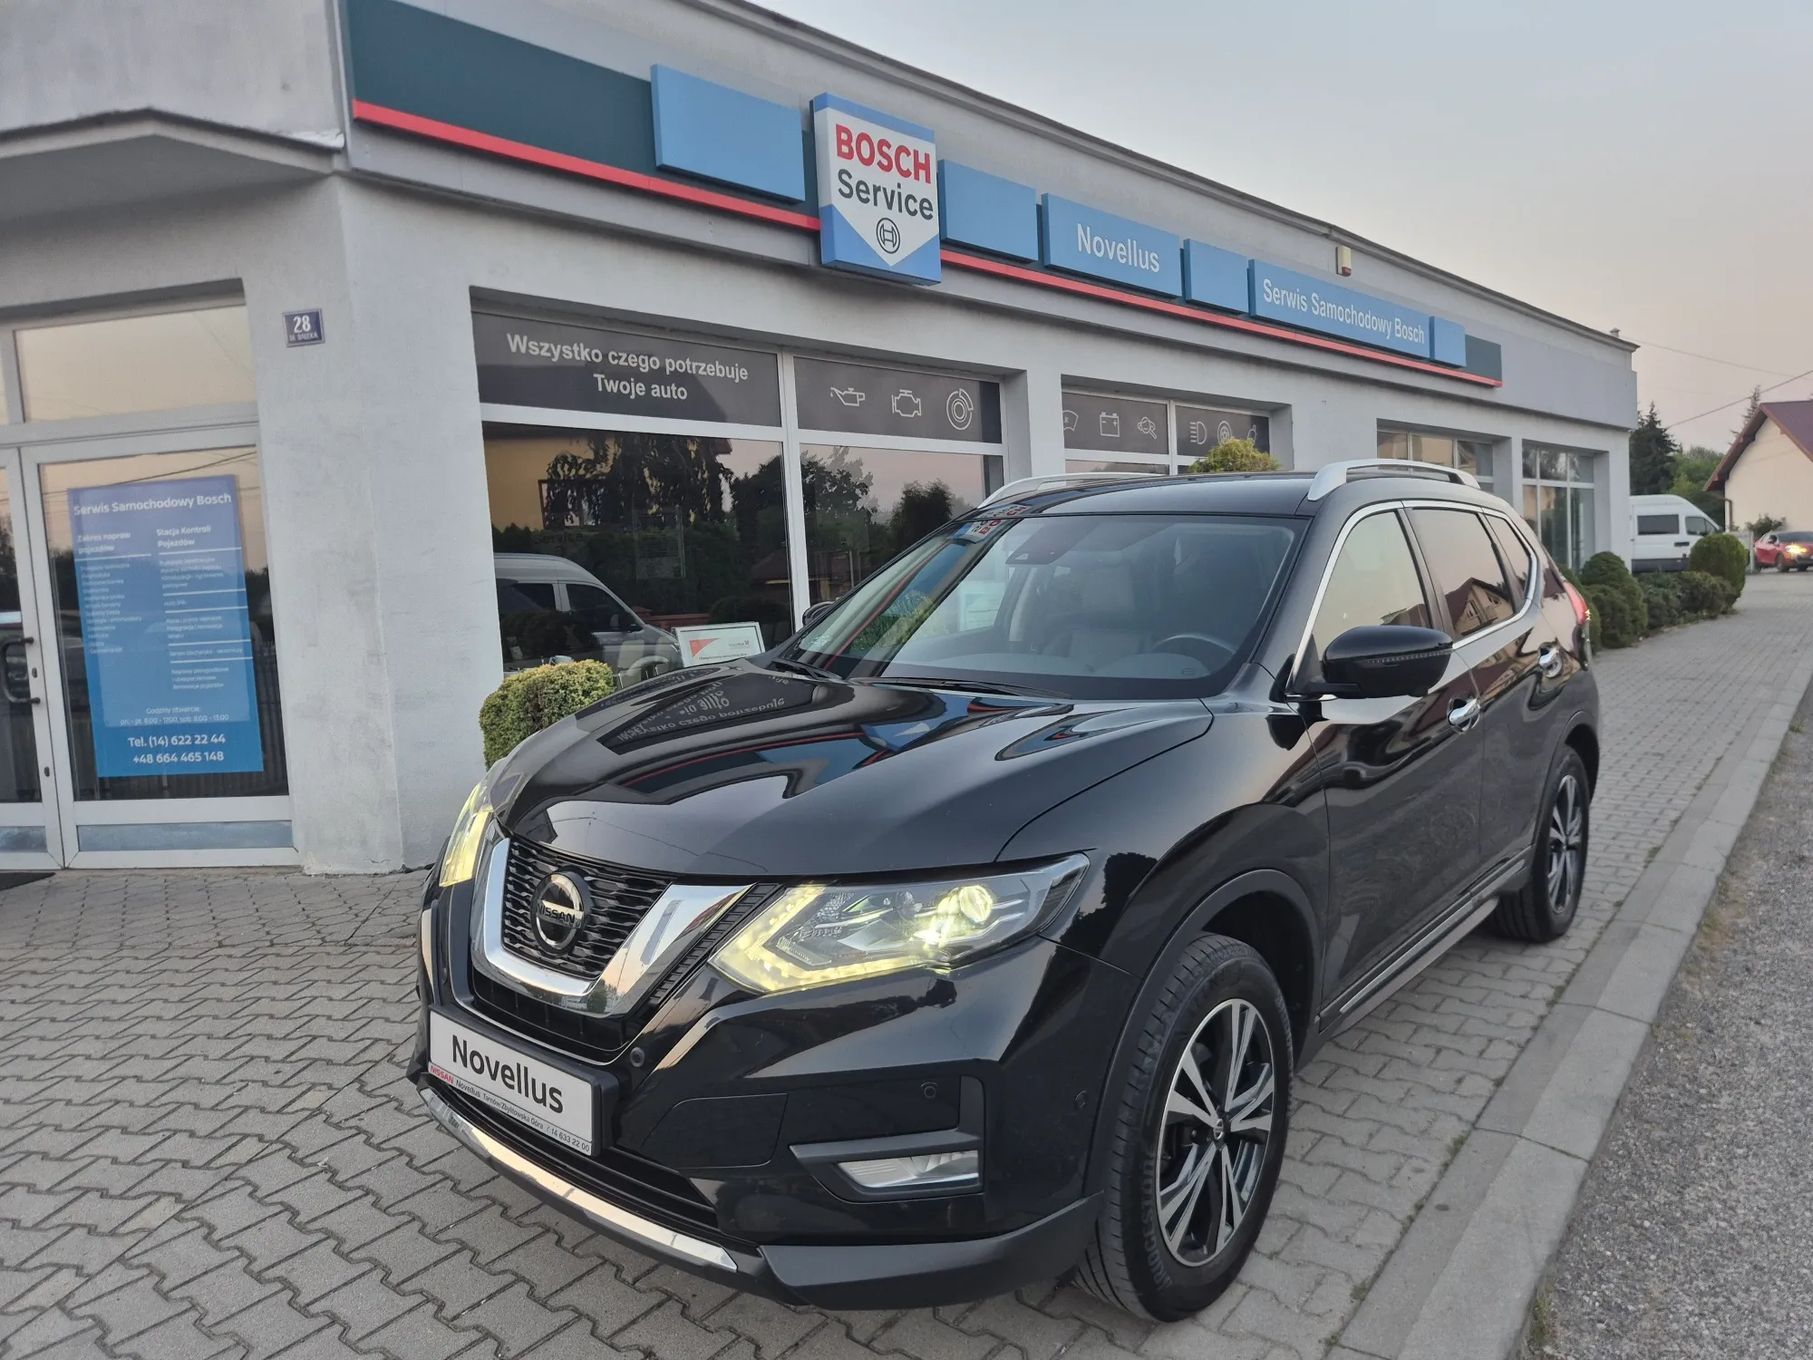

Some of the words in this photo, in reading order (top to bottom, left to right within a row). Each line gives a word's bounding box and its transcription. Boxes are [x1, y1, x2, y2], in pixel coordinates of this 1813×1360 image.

[835, 123, 932, 184] BOSCH
[837, 168, 934, 221] Service
[1076, 223, 1161, 274] Novellus
[293, 315, 311, 333] 28
[1263, 278, 1308, 312] Serwis
[1311, 292, 1392, 340] Samochodowy
[1394, 317, 1425, 345] Bosch
[506, 333, 603, 363] Wszystko
[607, 350, 660, 373] czego
[665, 357, 749, 383] potrzebuje
[593, 373, 646, 400] Twoje
[651, 383, 688, 400] auto
[73, 501, 110, 516] Serwis
[111, 496, 194, 513] Samochodowy
[196, 492, 232, 506] Bosch
[156, 527, 180, 537] Stacja
[181, 524, 212, 535] Kontroli
[128, 736, 148, 748] Tel.
[148, 734, 170, 749] (14)
[170, 734, 193, 746] 622
[194, 733, 209, 745] 22
[210, 732, 227, 744] 44
[133, 752, 154, 765] +48
[155, 752, 178, 764] 664
[180, 751, 203, 763] 465
[203, 750, 225, 762] 148
[540, 904, 576, 924] NISSAN
[452, 1034, 564, 1114] Novellus
[430, 1065, 455, 1084] NISSAN
[456, 1080, 481, 1098] Novellus
[571, 1137, 580, 1148] 22
[581, 1142, 590, 1152] 00
